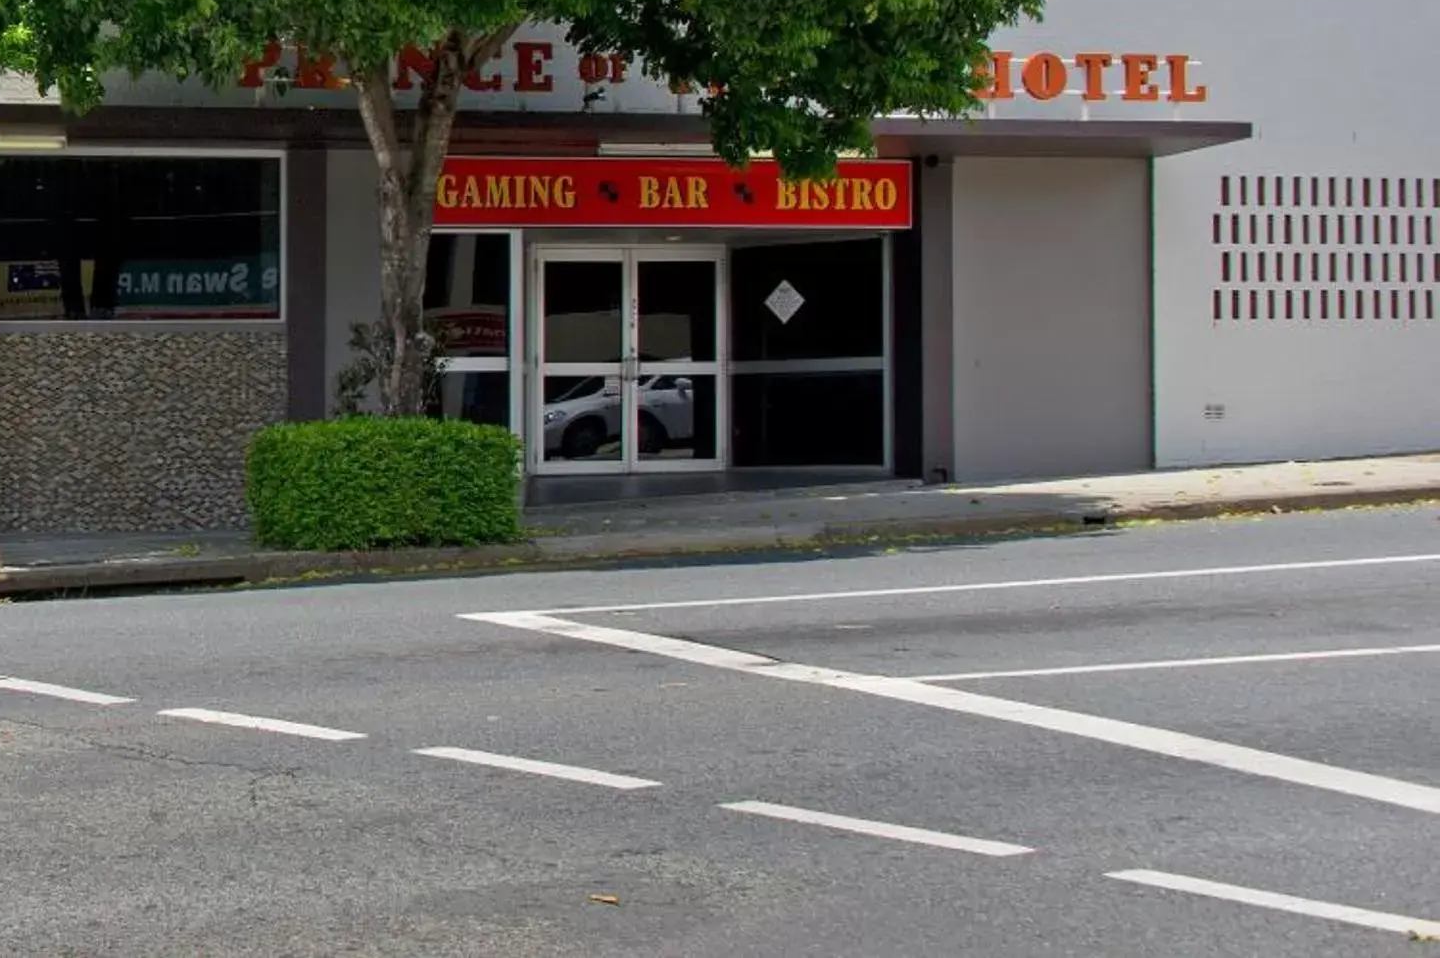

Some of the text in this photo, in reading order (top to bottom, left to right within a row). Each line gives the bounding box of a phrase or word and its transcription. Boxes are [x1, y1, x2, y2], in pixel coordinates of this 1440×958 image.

[436, 174, 897, 211] GAMING BAR BISTRO
